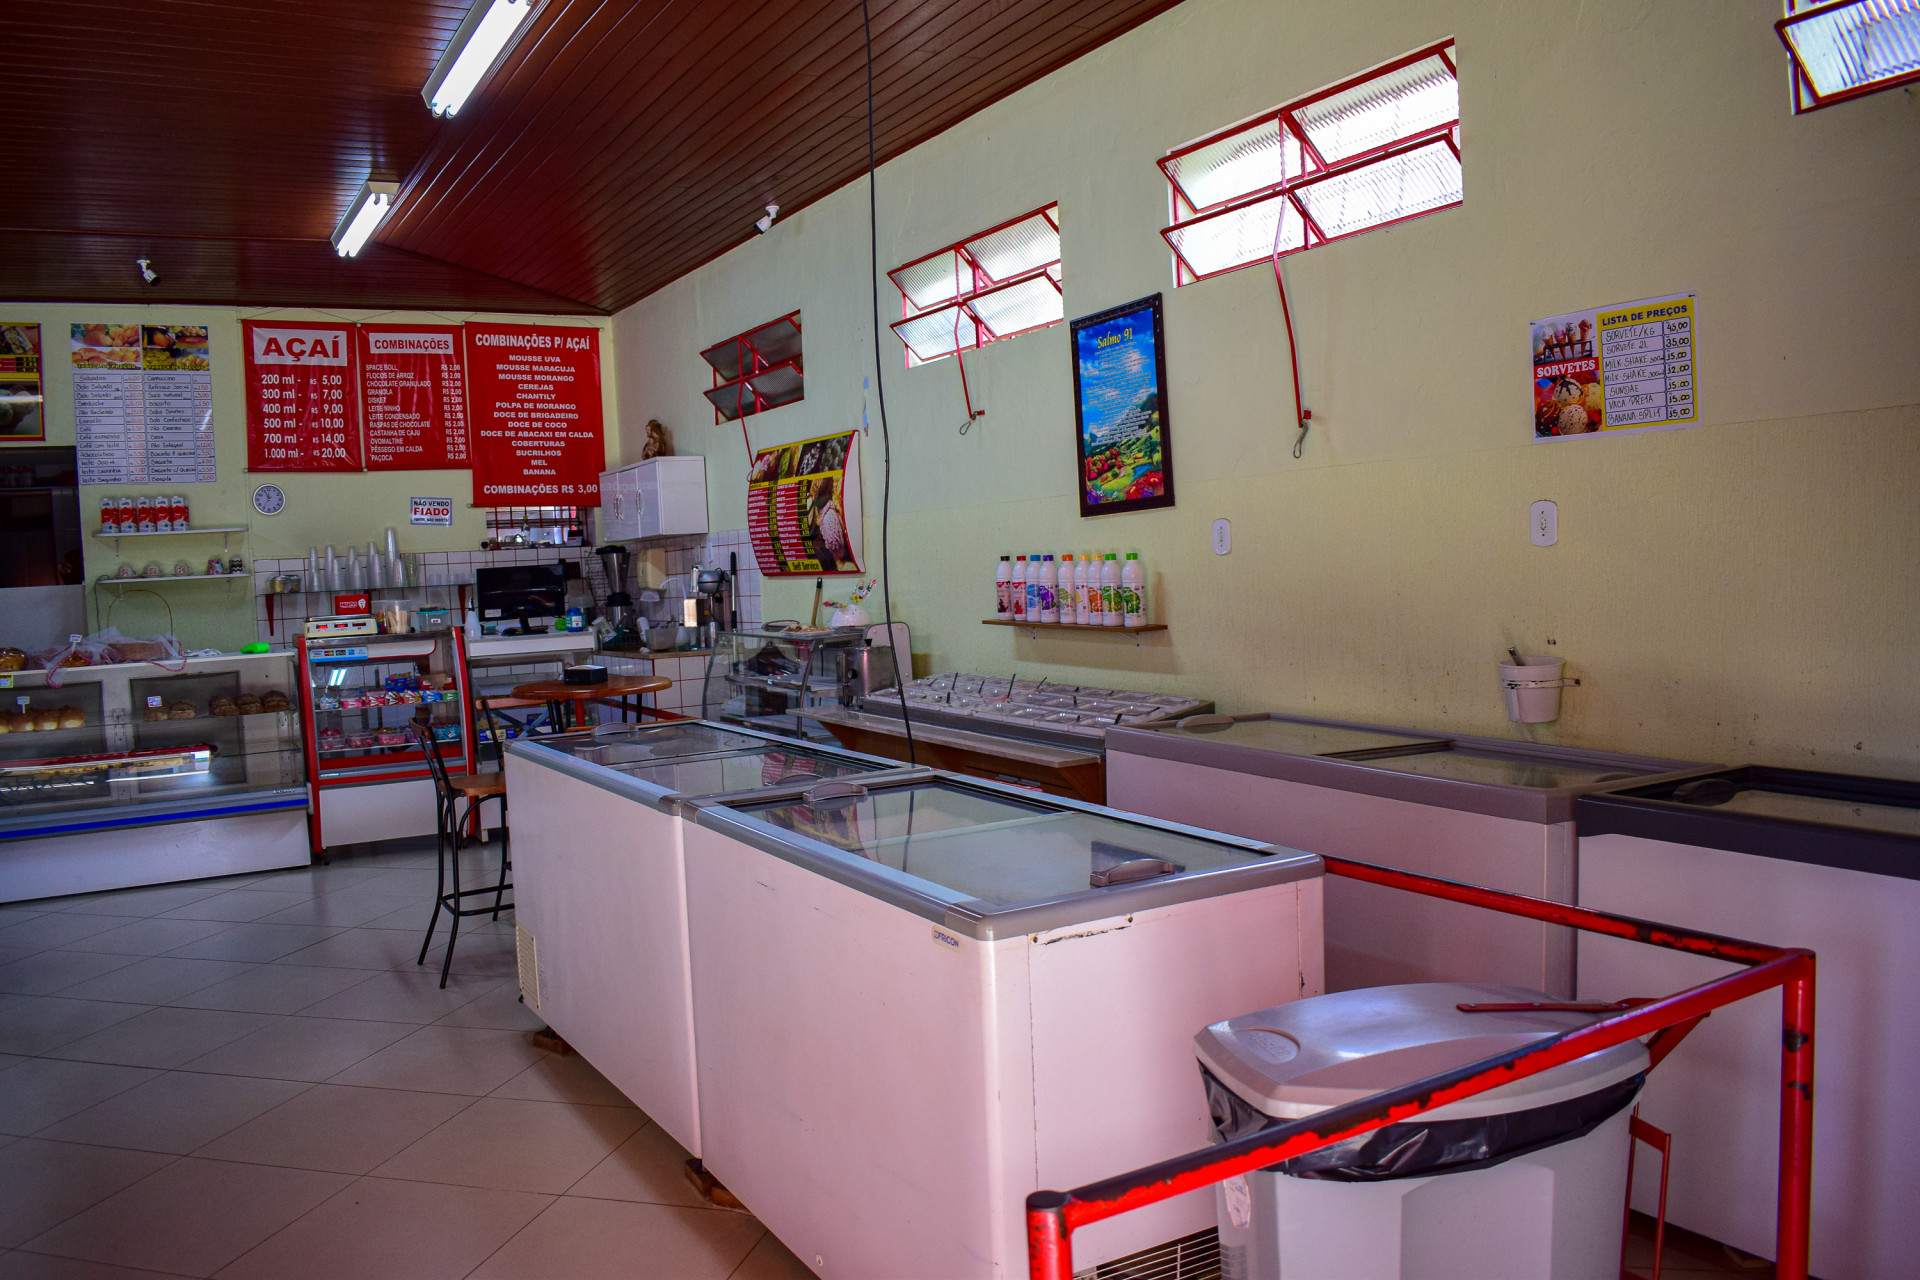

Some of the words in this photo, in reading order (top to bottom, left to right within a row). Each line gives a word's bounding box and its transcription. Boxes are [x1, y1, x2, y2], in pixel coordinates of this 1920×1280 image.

[1602, 315, 1628, 326] LISTA
[1631, 313, 1643, 321] DE
[1646, 305, 1687, 319] PREÇOS
[475, 333, 551, 350] COMBINAÇÕES
[554, 337, 564, 348] P/
[566, 336, 590, 352] AÇAÍ
[1097, 331, 1121, 349] Salmo
[1124, 327, 1133, 341] 91
[262, 334, 340, 362] AÇAÍ
[374, 338, 449, 352] COMBINAÇÕES
[1607, 342, 1635, 354] SORVETE
[1666, 337, 1690, 347] 35,00
[1625, 355, 1648, 368] SHAKE
[1537, 360, 1596, 378] SORVETES
[1622, 369, 1646, 381] SHAKE
[261, 374, 279, 385] 200
[282, 374, 294, 385] ml
[322, 375, 342, 386] 5,00
[262, 389, 281, 399] 300
[283, 389, 296, 399] ml
[323, 389, 343, 400] 7,00
[1610, 384, 1639, 396] SUNDAE
[263, 403, 281, 414] 400
[283, 403, 296, 414] ml
[324, 404, 343, 415] 9,00
[1607, 410, 1638, 424] BANANA
[264, 418, 281, 428] 500
[284, 418, 296, 428] ml
[320, 418, 344, 429] 10,00
[264, 433, 282, 444] 700
[284, 433, 297, 444] ml
[321, 433, 344, 444] 14,00
[264, 448, 286, 458] 1.000
[288, 448, 298, 458] ml
[322, 448, 346, 459] 20,00
[484, 484, 559, 496] COMBINAÇÕES
[561, 485, 574, 495] R$
[578, 484, 597, 494] 3,00
[414, 508, 449, 516] FIADO
[792, 562, 801, 570] Self
[802, 561, 819, 570] Service
